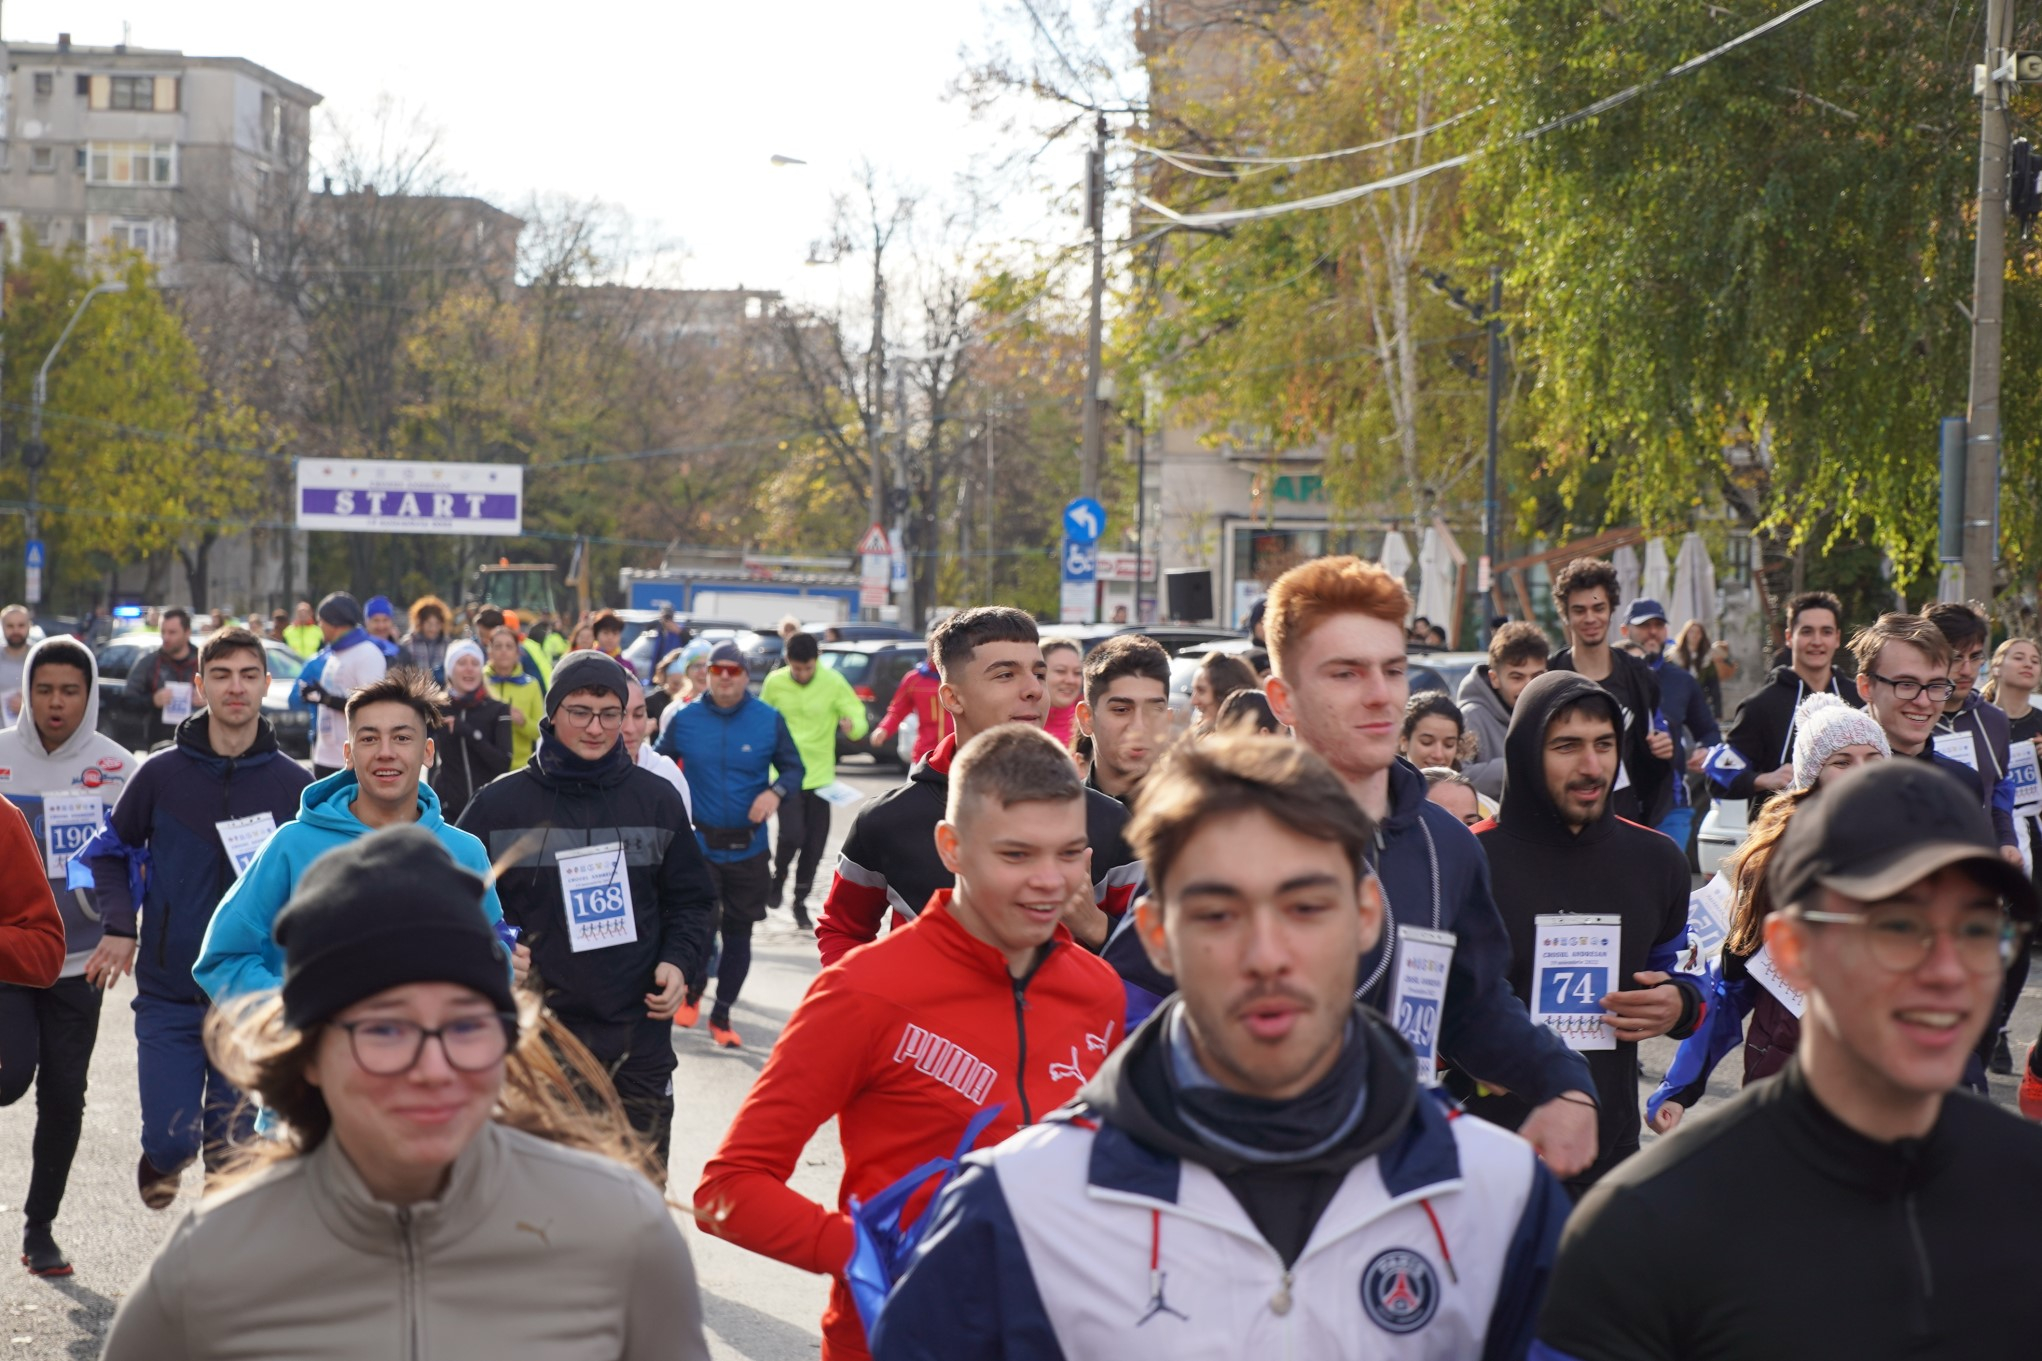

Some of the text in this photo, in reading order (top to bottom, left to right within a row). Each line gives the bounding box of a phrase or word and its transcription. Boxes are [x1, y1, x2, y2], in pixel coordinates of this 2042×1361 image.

[335, 490, 486, 518] START
[54, 825, 96, 849] 190
[574, 886, 623, 917] 168
[1552, 972, 1595, 1004] 74
[1400, 1002, 1436, 1047] 249
[893, 1022, 998, 1106] PUMA
